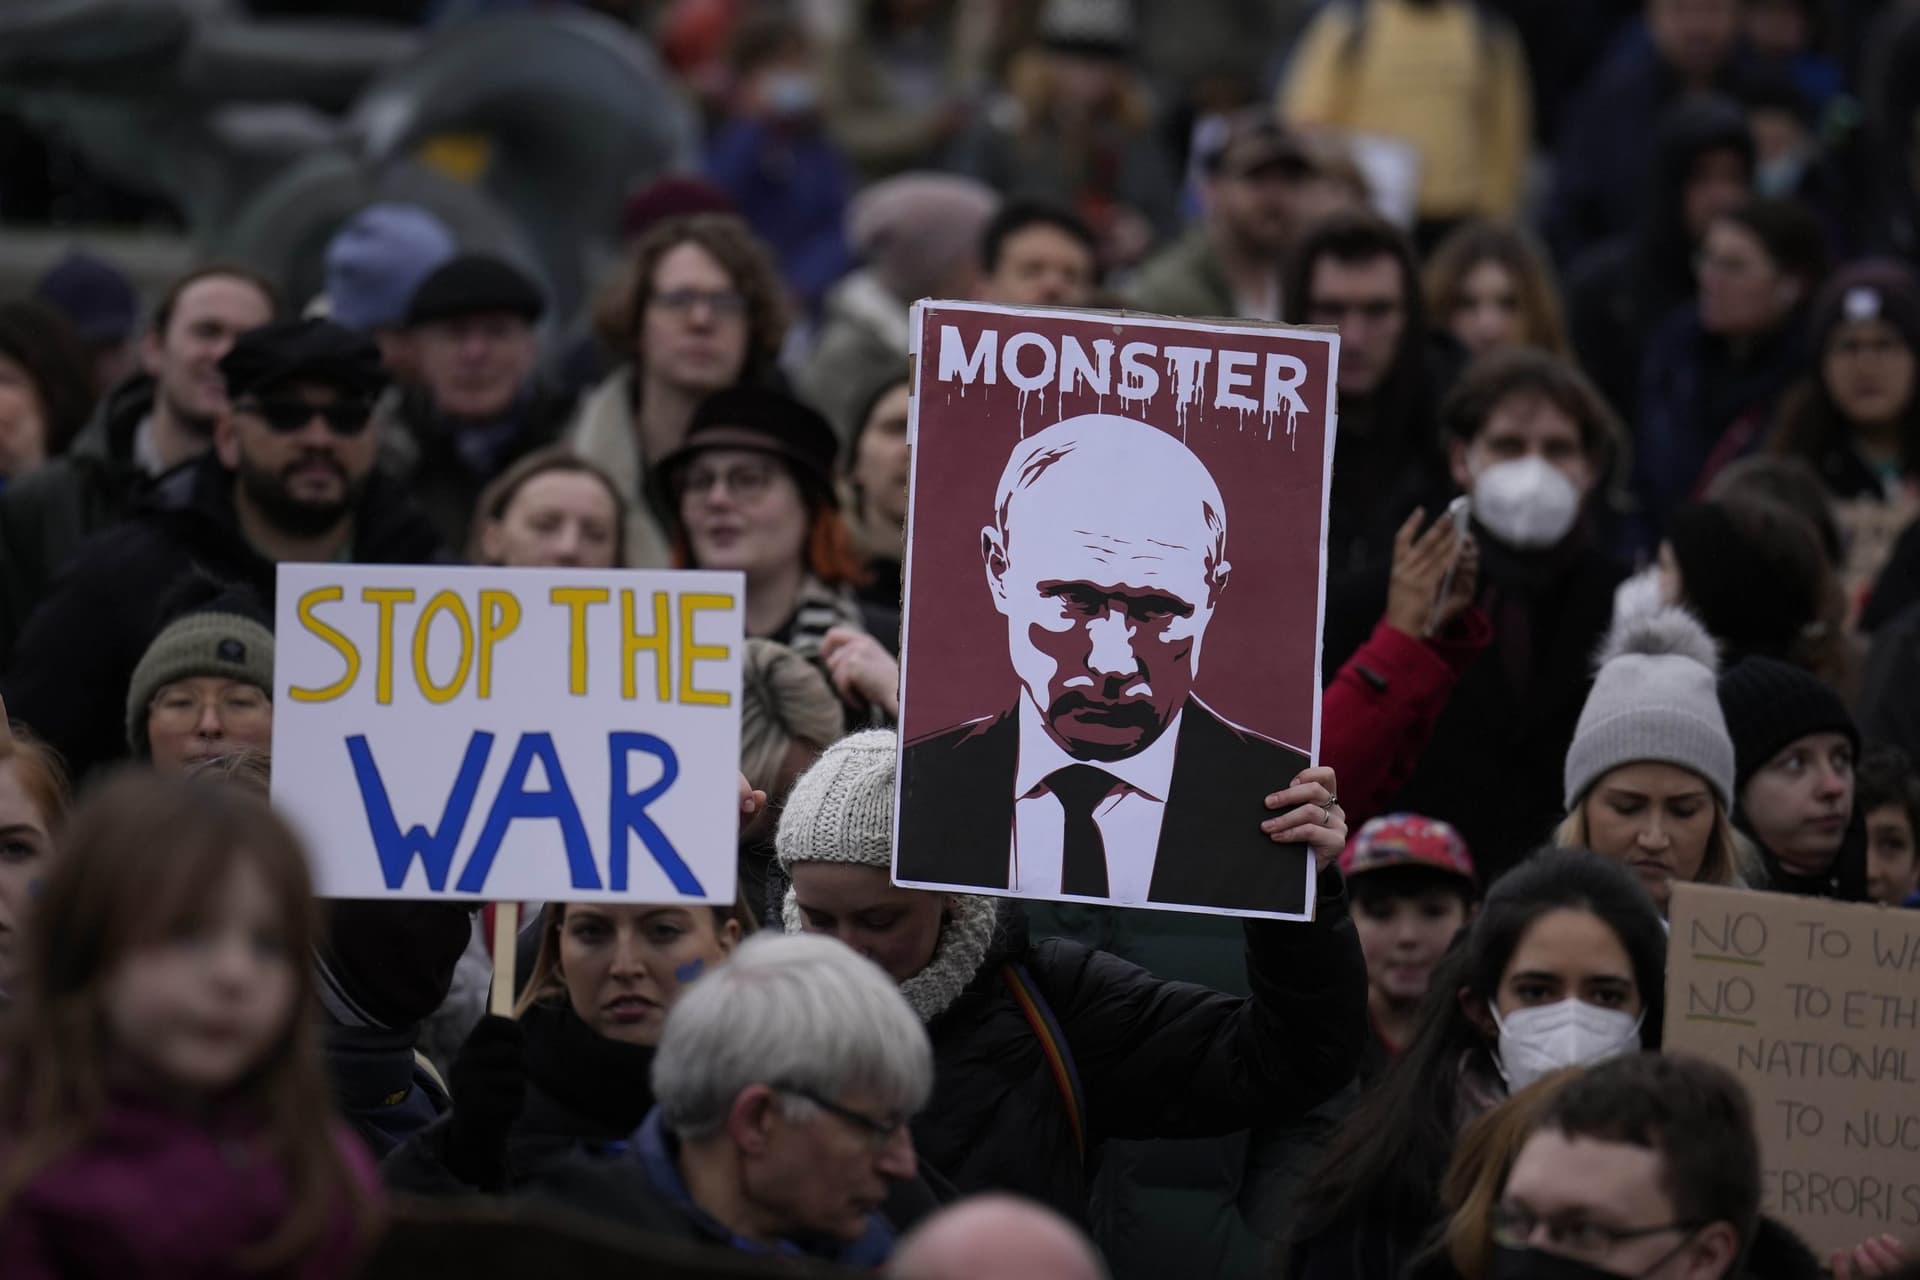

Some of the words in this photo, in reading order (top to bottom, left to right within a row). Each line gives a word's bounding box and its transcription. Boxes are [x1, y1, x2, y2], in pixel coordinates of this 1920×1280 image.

[938, 325, 1310, 418] MONSTER
[288, 586, 521, 705] STOP
[550, 587, 735, 707] THE
[345, 730, 707, 897] WAR
[1690, 911, 1768, 957] NO
[1795, 921, 1851, 961] TO
[1688, 976, 1756, 1015] NO
[1784, 983, 1832, 1019] TO
[1843, 991, 1917, 1029] ETH
[1738, 1039, 1917, 1083] NATIONAL
[1776, 1099, 1825, 1141] TO
[1843, 1109, 1920, 1152] NUC
